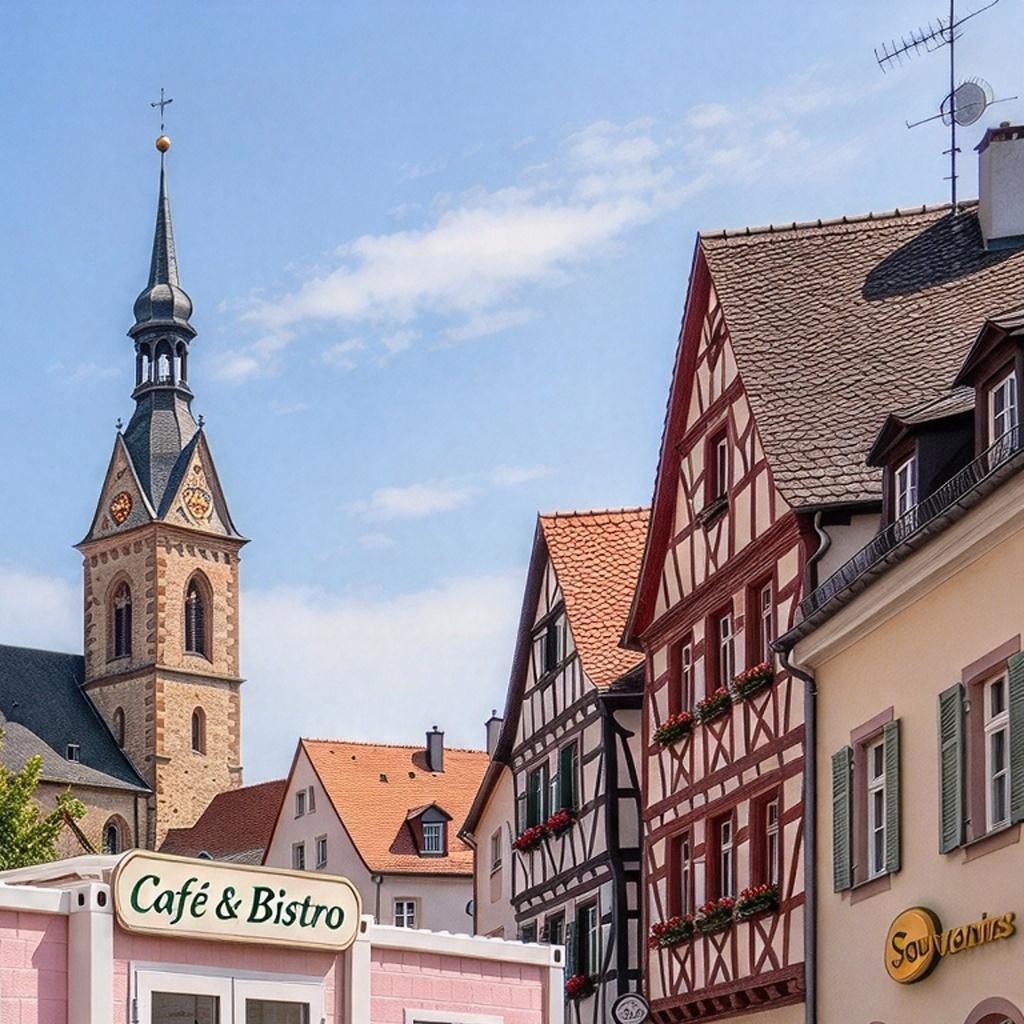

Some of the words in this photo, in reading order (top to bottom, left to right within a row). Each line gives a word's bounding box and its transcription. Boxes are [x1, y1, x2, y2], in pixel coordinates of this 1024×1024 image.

[131, 874, 211, 925] Café
[215, 886, 243, 920] &
[247, 886, 345, 930] Bistro
